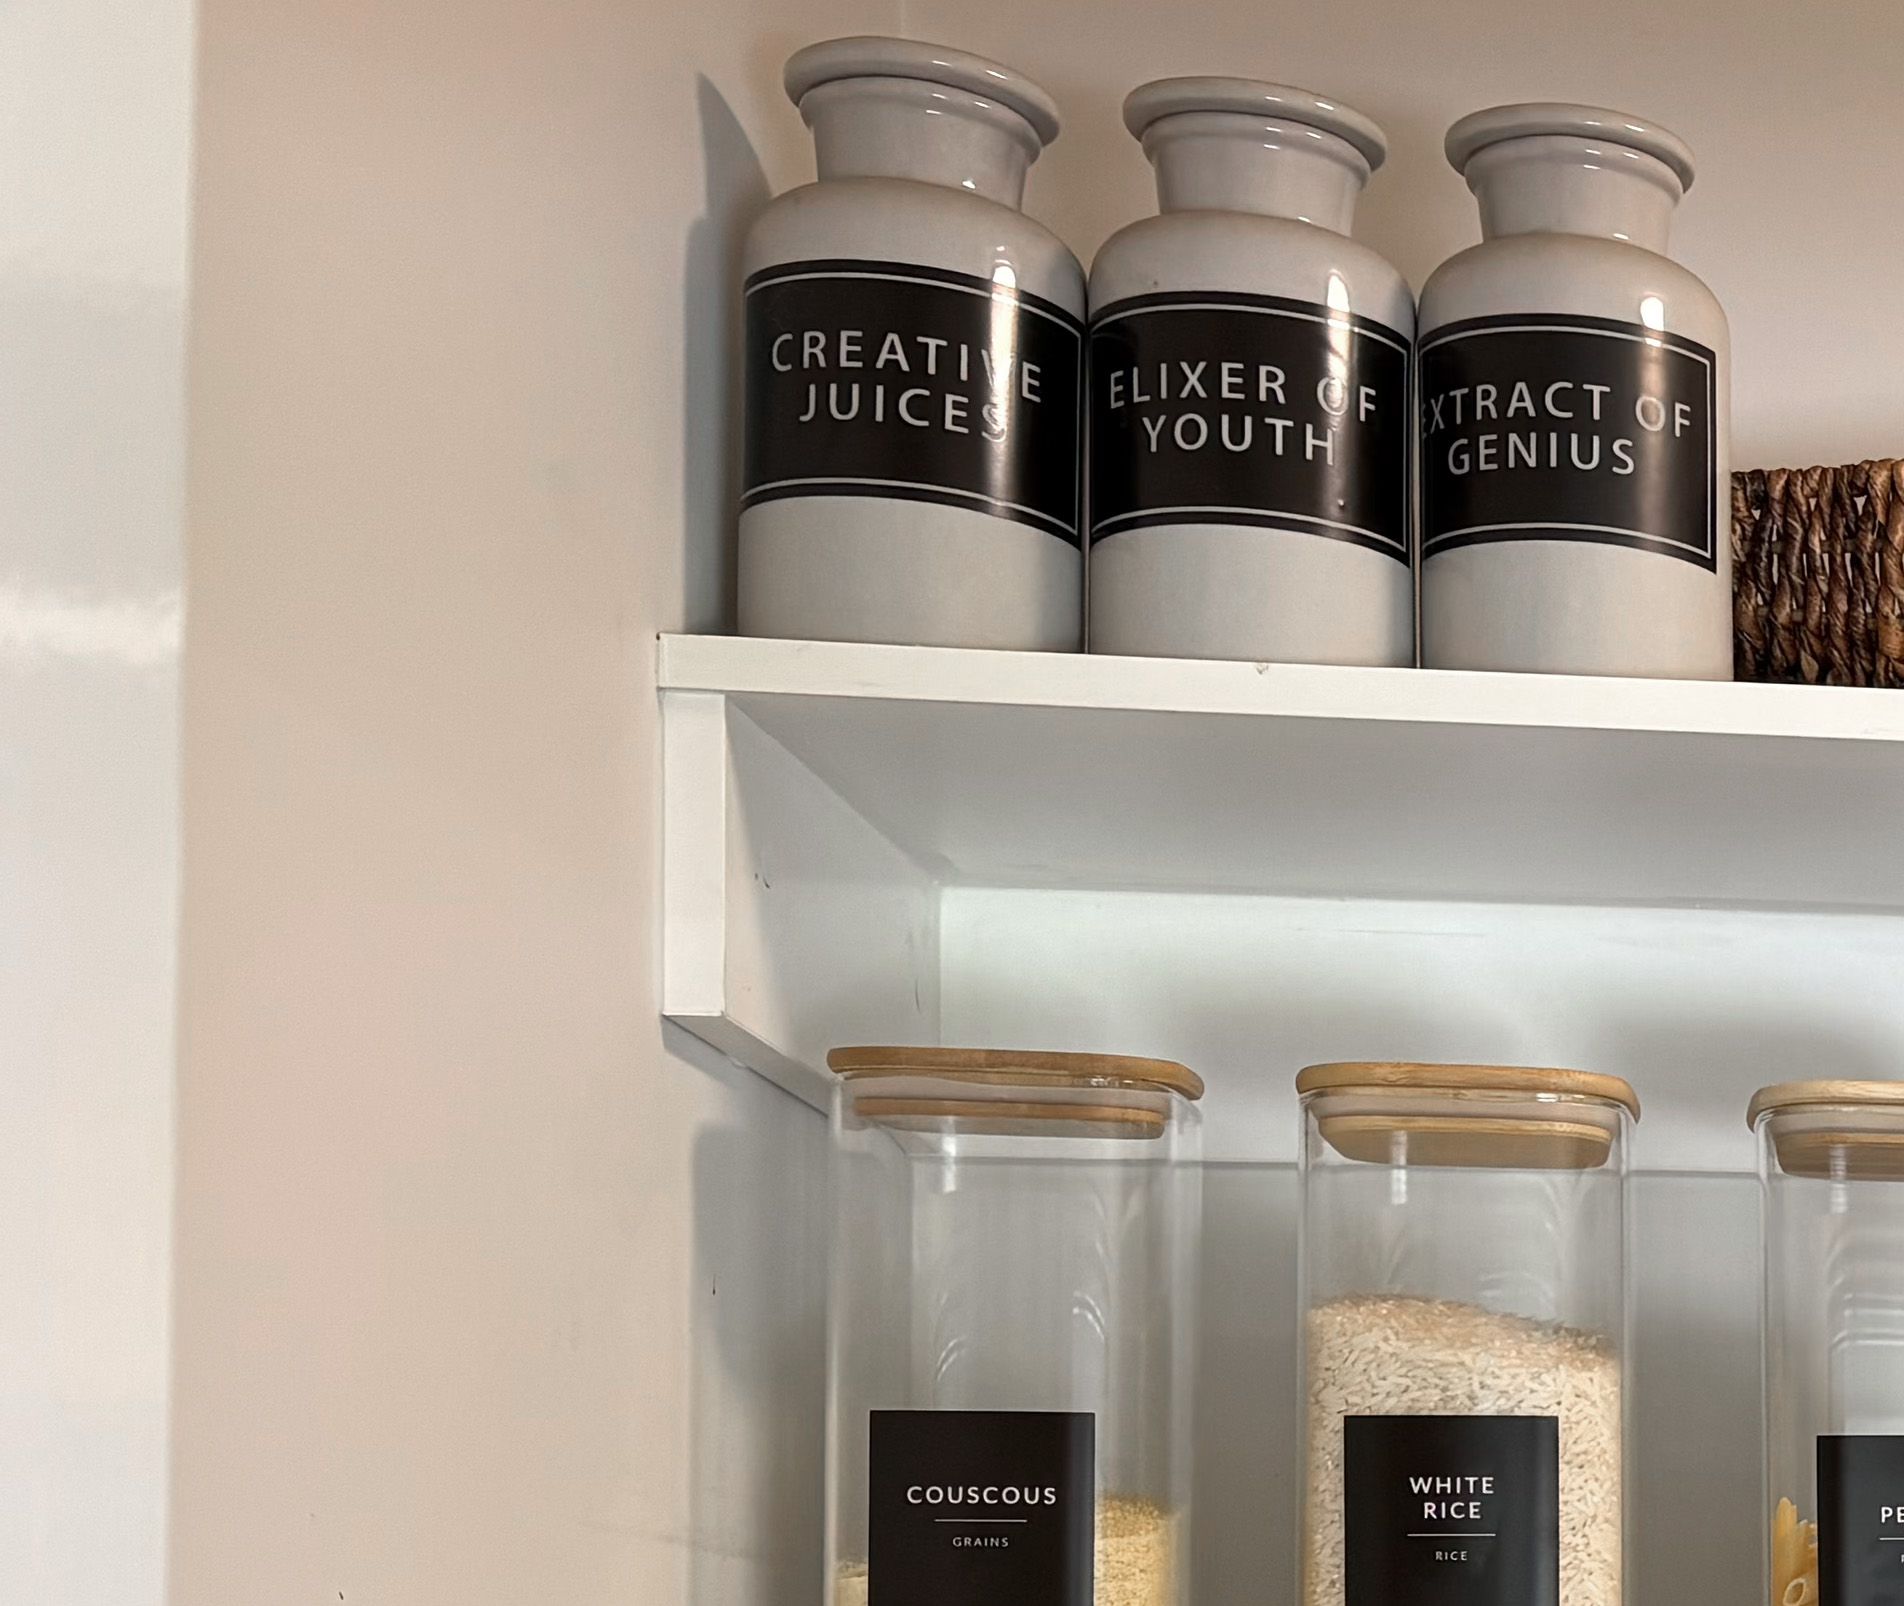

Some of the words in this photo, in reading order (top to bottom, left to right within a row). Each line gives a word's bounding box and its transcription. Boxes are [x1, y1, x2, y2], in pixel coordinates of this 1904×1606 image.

[771, 330, 1041, 402] CREATIVE
[799, 382, 1006, 442] JUICES
[1109, 361, 1286, 410] ELIXER
[1317, 377, 1377, 423] OF
[1635, 395, 1692, 439] OF
[1141, 413, 1336, 467] YOUTH
[1447, 435, 1636, 475] GENIUS
[906, 1485, 1057, 1506] COUSCOUS
[1410, 1475, 1494, 1496] WHITE
[1423, 1501, 1482, 1520] RICE
[952, 1536, 1009, 1548] GRAINS
[1435, 1550, 1468, 1561] RICE
